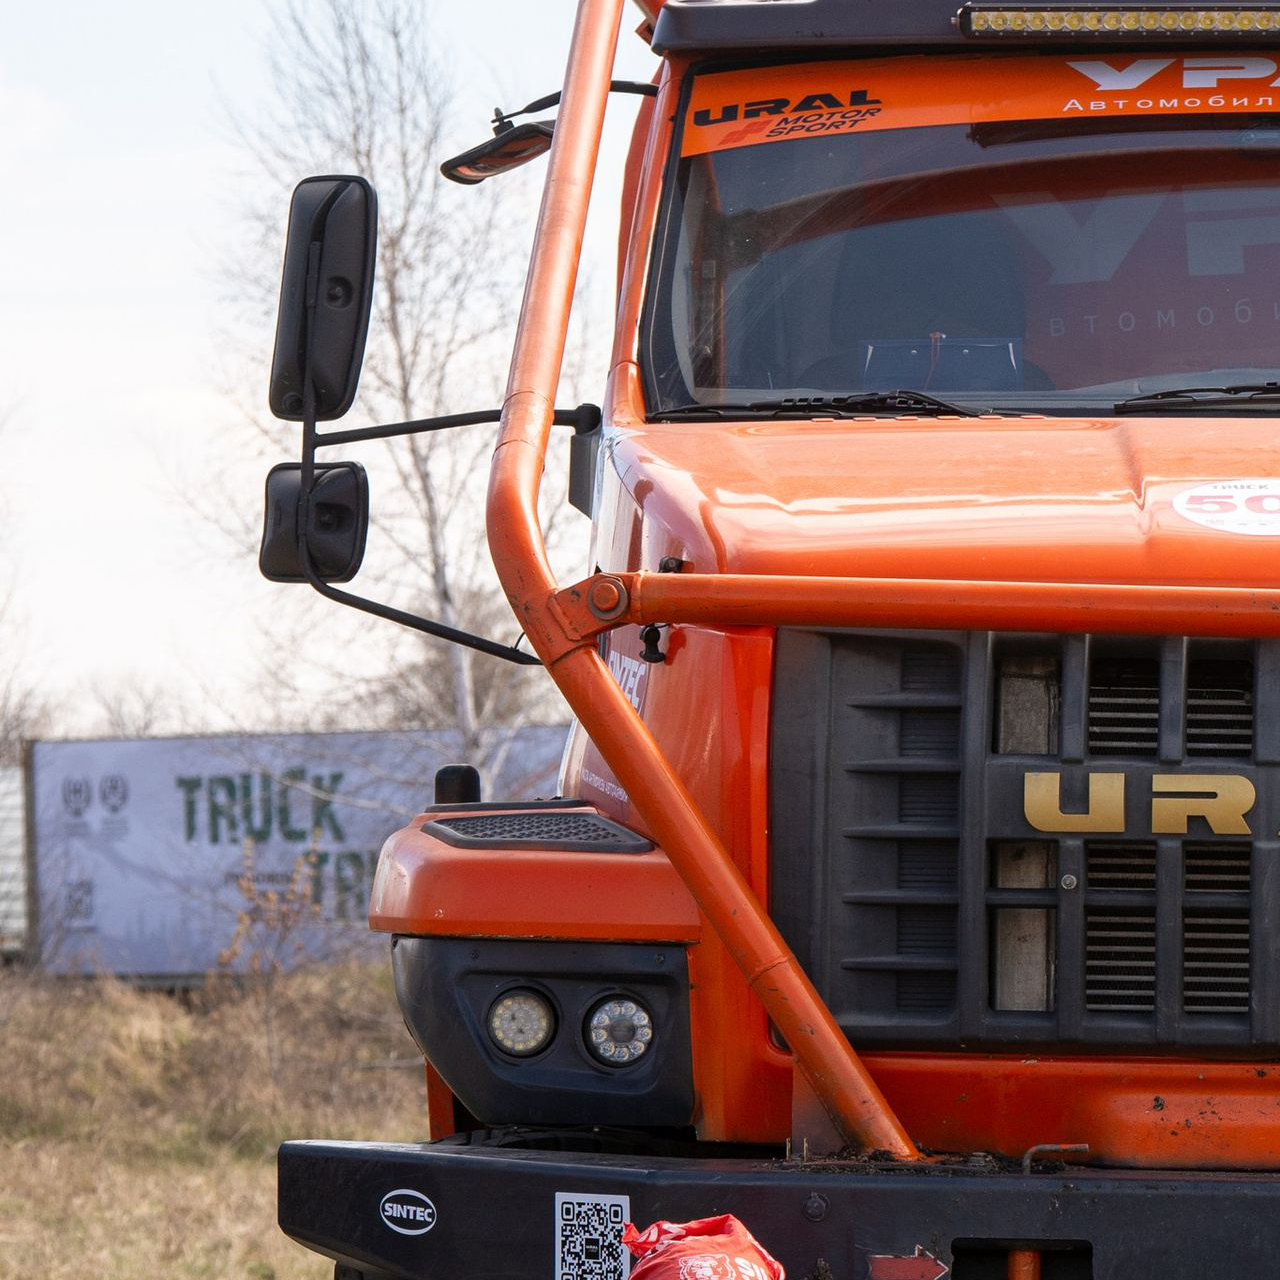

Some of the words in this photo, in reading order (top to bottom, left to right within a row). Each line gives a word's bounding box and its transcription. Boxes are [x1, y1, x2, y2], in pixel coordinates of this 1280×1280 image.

[693, 89, 882, 127] URAL
[775, 107, 882, 127] MOTOR
[765, 119, 867, 138] SPORT
[175, 767, 345, 844] TRUCK
[384, 1202, 433, 1222] SINTEC
